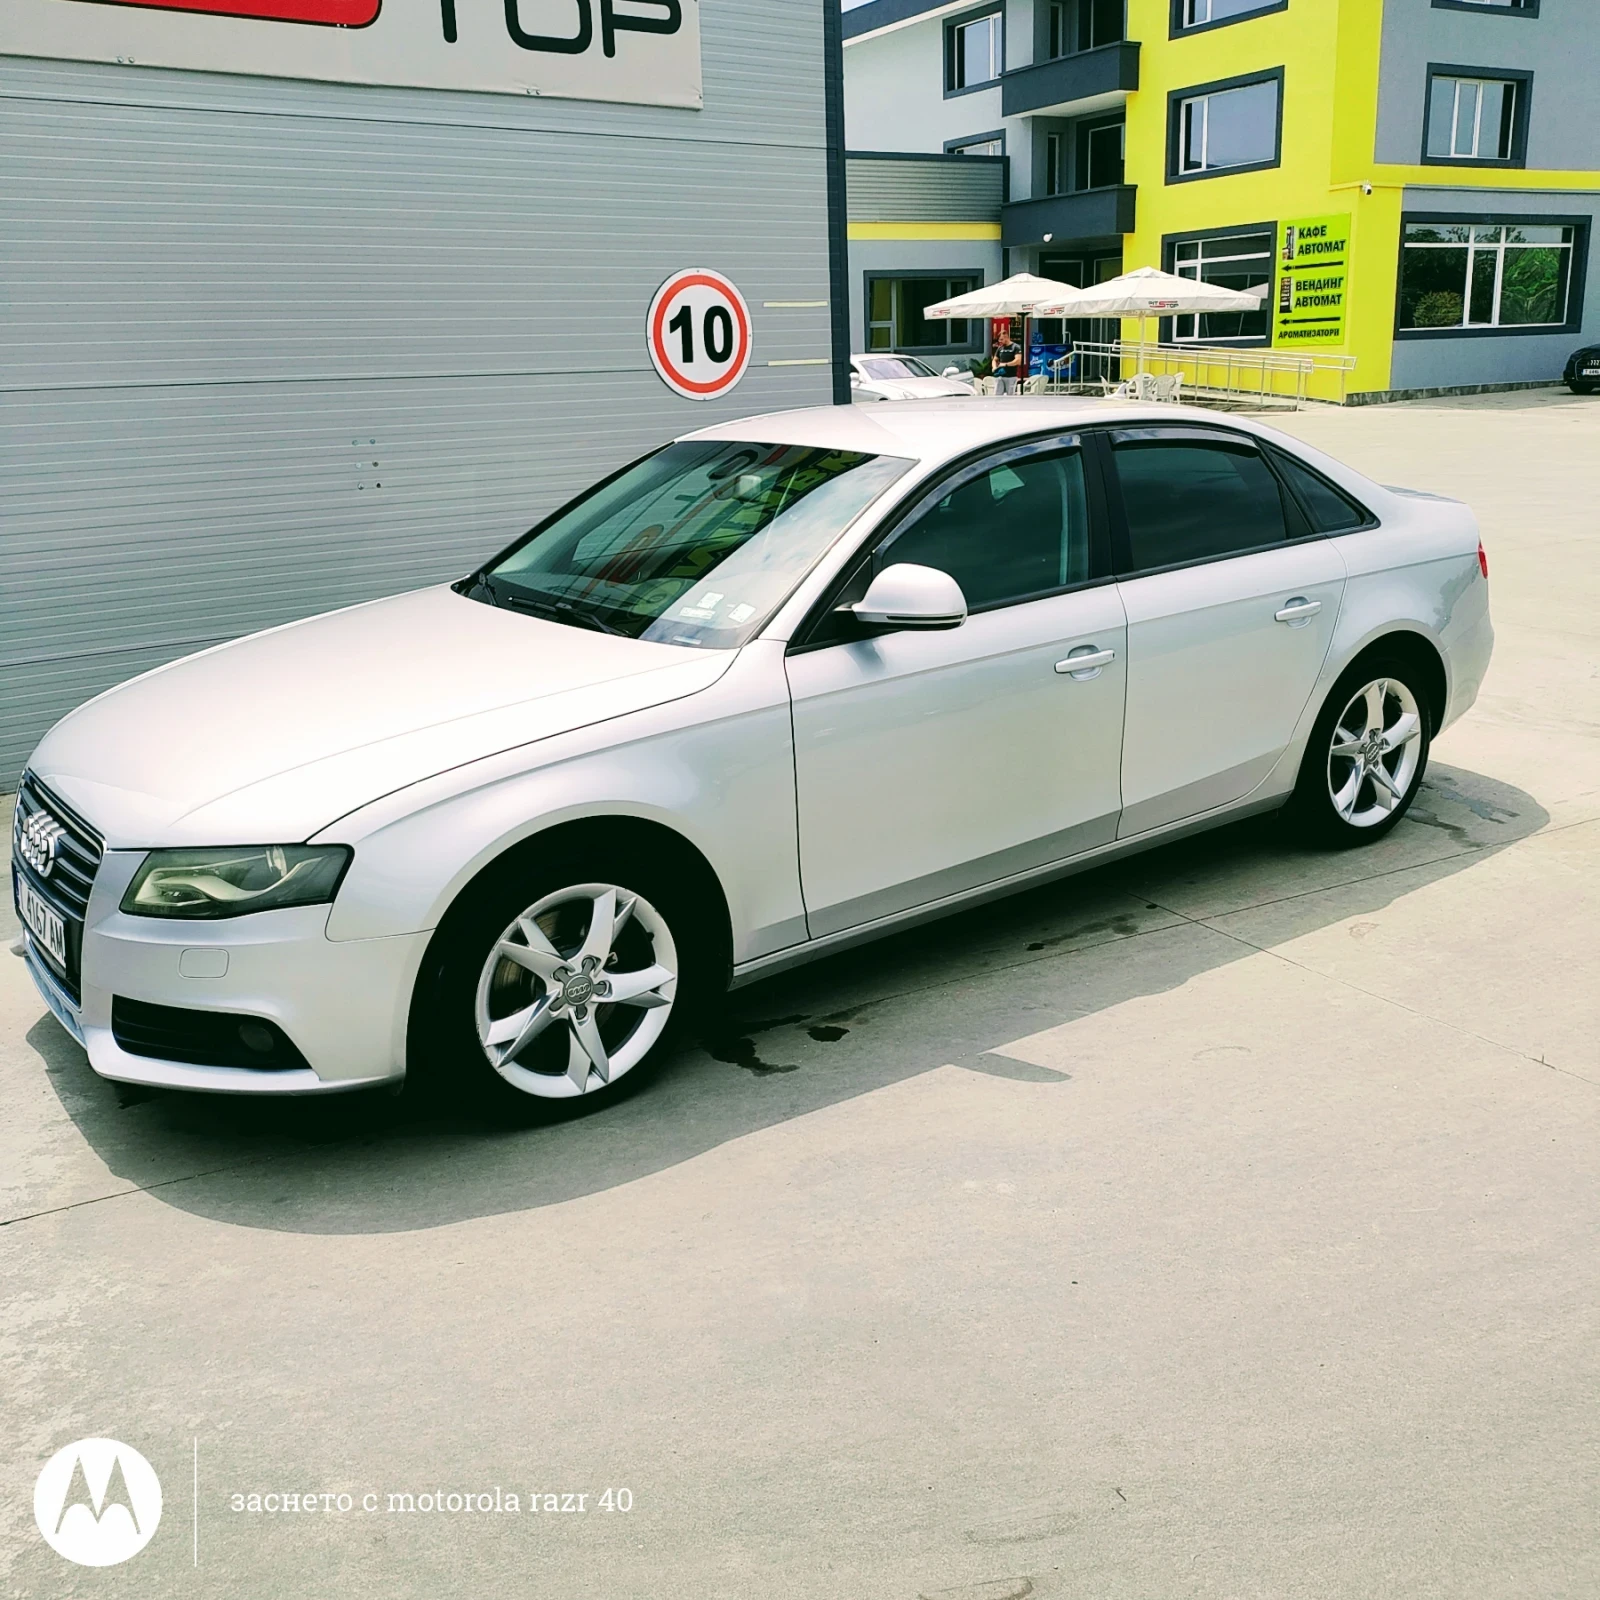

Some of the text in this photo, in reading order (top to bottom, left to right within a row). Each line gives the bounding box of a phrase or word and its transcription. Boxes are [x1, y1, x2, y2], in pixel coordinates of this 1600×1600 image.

[1298, 225, 1328, 239] КАФЕ
[1297, 239, 1346, 256] АВТОМАТ
[1295, 277, 1344, 292] ВЕНДИНГ
[1294, 294, 1343, 308] АВТОМАТ
[669, 305, 734, 364] 10
[1278, 328, 1340, 339] АРОМАТИЗАТОРИ
